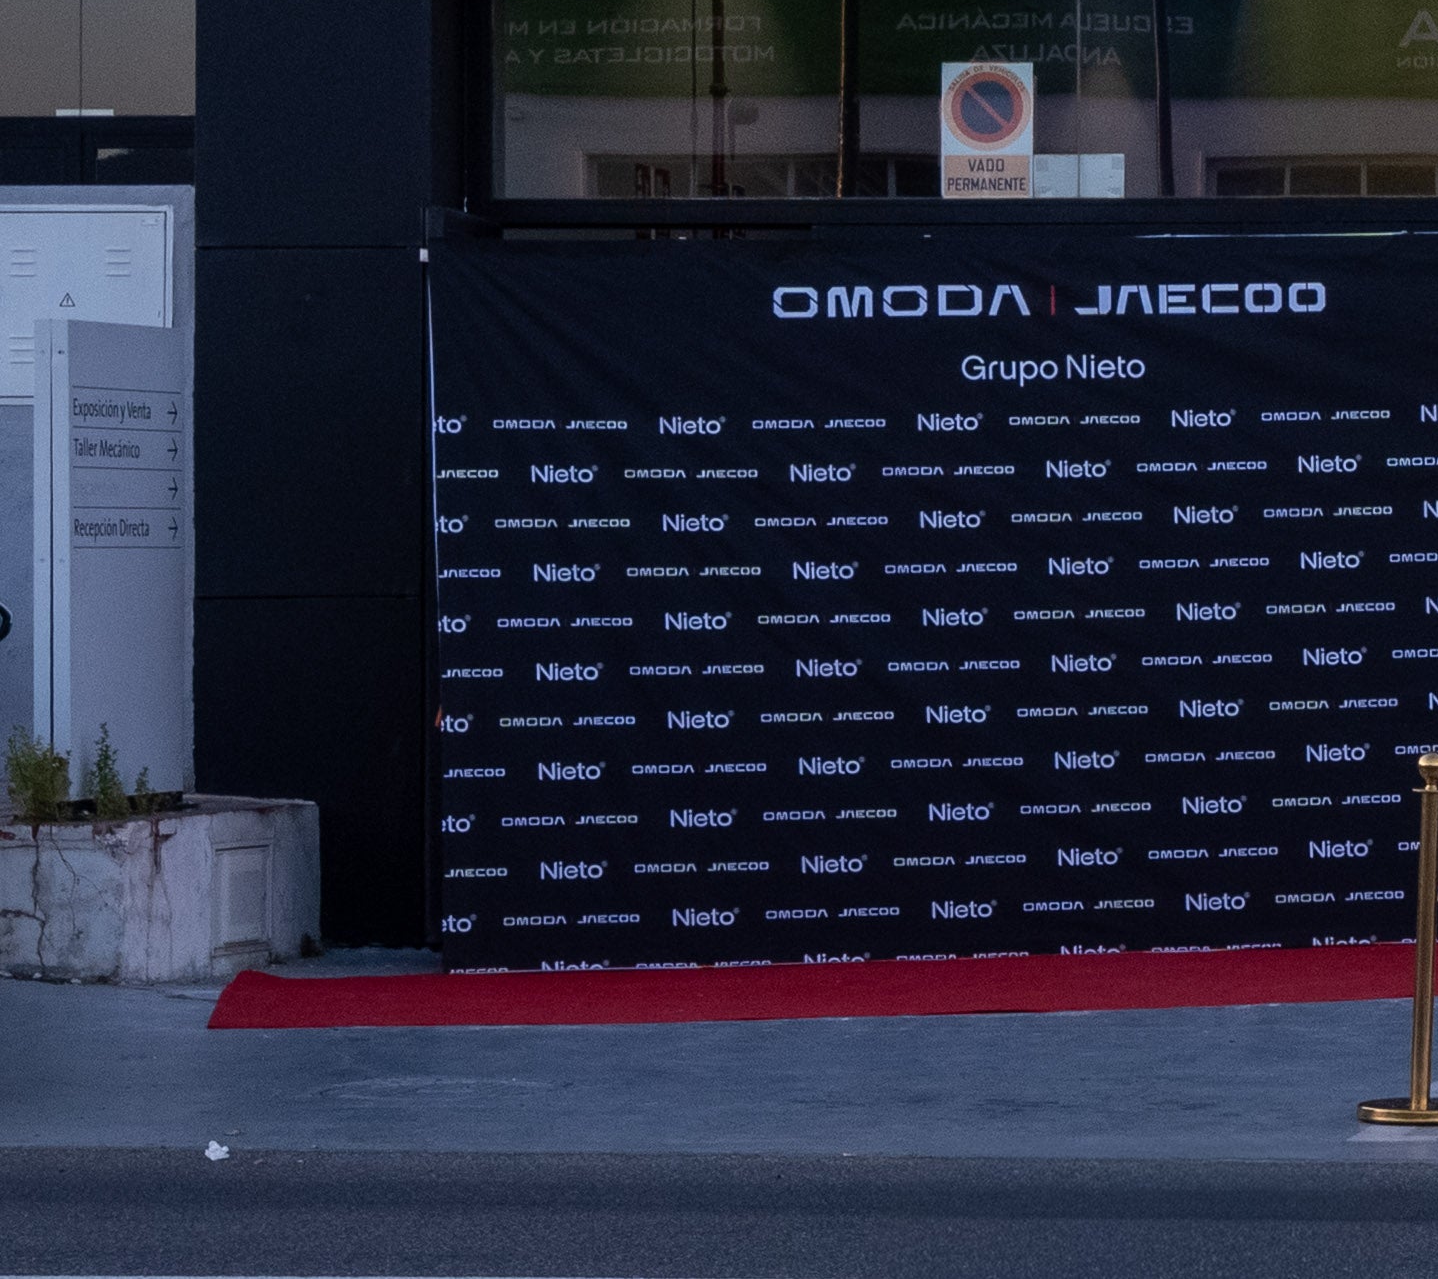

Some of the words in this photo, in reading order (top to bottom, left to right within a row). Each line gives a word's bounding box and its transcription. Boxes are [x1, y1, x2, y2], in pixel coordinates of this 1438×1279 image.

[967, 158, 1005, 172] VADO
[947, 177, 1027, 192] PERMANENTE
[773, 284, 1032, 319] OMODA
[1074, 282, 1328, 316] JAECOO
[960, 354, 1058, 387] Grupo
[1066, 350, 1146, 382] Nieto
[73, 398, 119, 422] Exposición
[126, 401, 151, 420] Venta
[492, 419, 556, 430] OMODA
[565, 420, 628, 430] JAECOO
[751, 419, 815, 430] OMODA
[824, 418, 887, 429] JAECOO
[1008, 415, 1071, 426] OMODA
[1079, 414, 1141, 425] JAECOO
[1260, 410, 1322, 422] OMODA
[1330, 409, 1391, 421] JAECOO
[73, 438, 97, 457] Taller
[99, 439, 141, 459] Mecánico
[623, 468, 687, 479] OMODA
[695, 468, 759, 479] JAECOO
[881, 466, 945, 477] OMODA
[953, 465, 1015, 476] JAECOO
[1136, 462, 1198, 473] OMODA
[1206, 460, 1268, 471] JAECOO
[494, 518, 558, 529] OMODA
[567, 518, 631, 528] JAECOO
[754, 517, 817, 527] OMODA
[826, 515, 889, 526] JAECOO
[1010, 512, 1073, 523] OMODA
[1081, 511, 1143, 522] JAECOO
[1263, 507, 1324, 518] OMODA
[1333, 505, 1393, 517] JAECOO
[74, 517, 118, 542] Recepción
[119, 518, 150, 538] Directa
[626, 566, 690, 577] OMODA
[699, 566, 762, 577] JAECOO
[884, 563, 947, 575] OMODA
[955, 562, 1018, 573] JAECOO
[1138, 558, 1200, 570] OMODA
[1209, 557, 1270, 568] JAECOO
